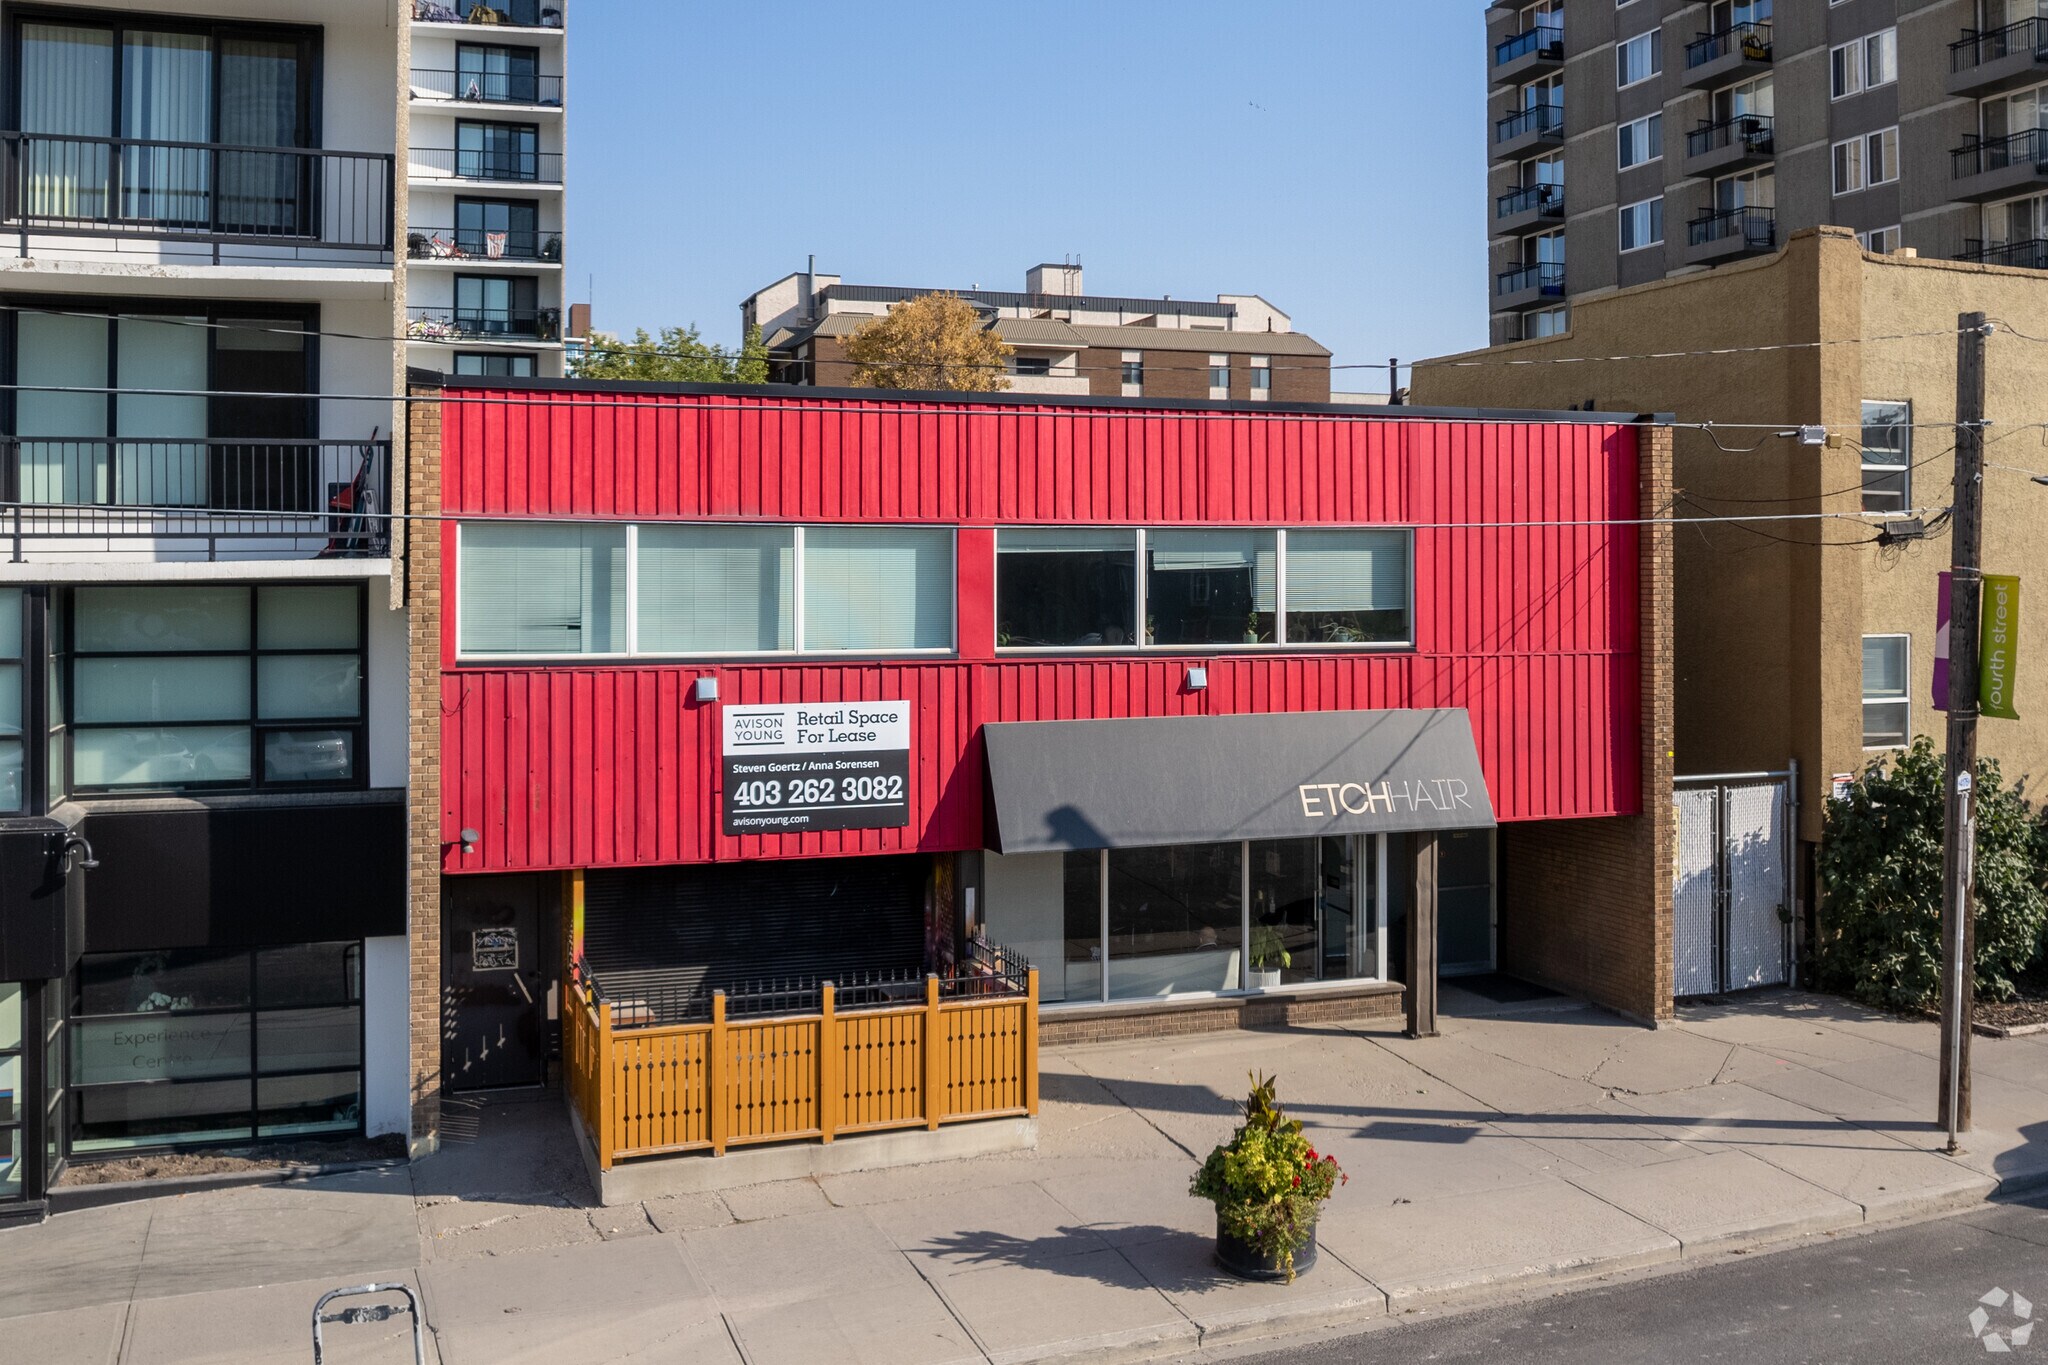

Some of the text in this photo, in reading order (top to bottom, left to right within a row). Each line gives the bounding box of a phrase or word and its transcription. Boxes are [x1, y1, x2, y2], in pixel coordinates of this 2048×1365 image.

[1990, 583, 2009, 711] fourth street
[734, 717, 783, 729] AVISON
[796, 709, 899, 728] Retail Space
[734, 730, 783, 741] YOUNG
[796, 728, 877, 744] For Lease
[732, 763, 766, 774] Steven
[767, 762, 801, 773] Goertz
[808, 761, 834, 771] Anna
[835, 760, 880, 770] Sorensen
[733, 775, 903, 806] 403 262 3082
[732, 814, 809, 828] avisonyoung.com
[113, 1028, 211, 1048] Experience
